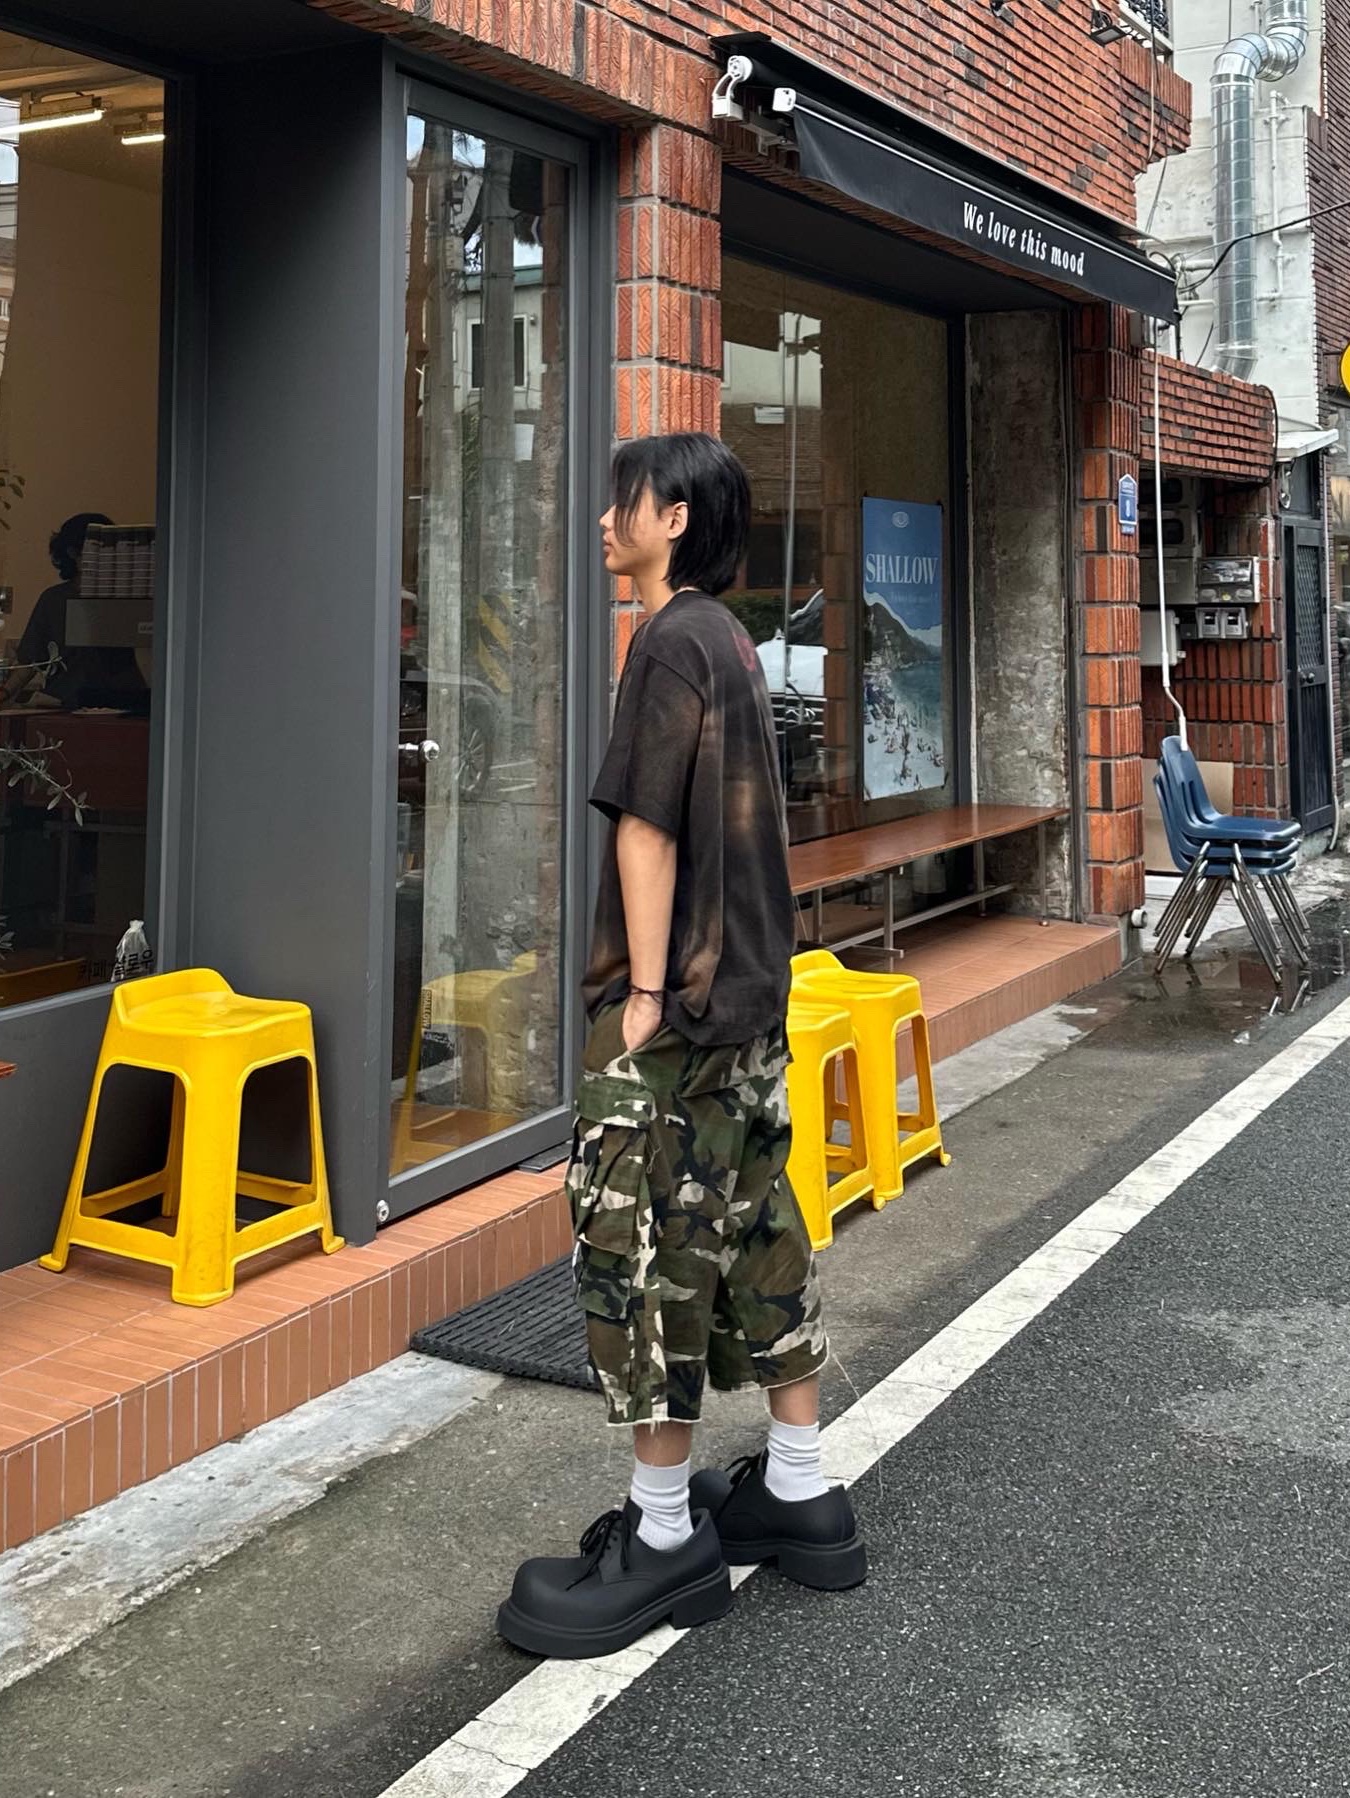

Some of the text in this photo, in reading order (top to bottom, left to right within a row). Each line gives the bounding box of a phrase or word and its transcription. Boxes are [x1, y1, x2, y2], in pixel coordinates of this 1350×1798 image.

[964, 201, 1085, 276] We love this mood
[865, 553, 938, 585] SHALLOW
